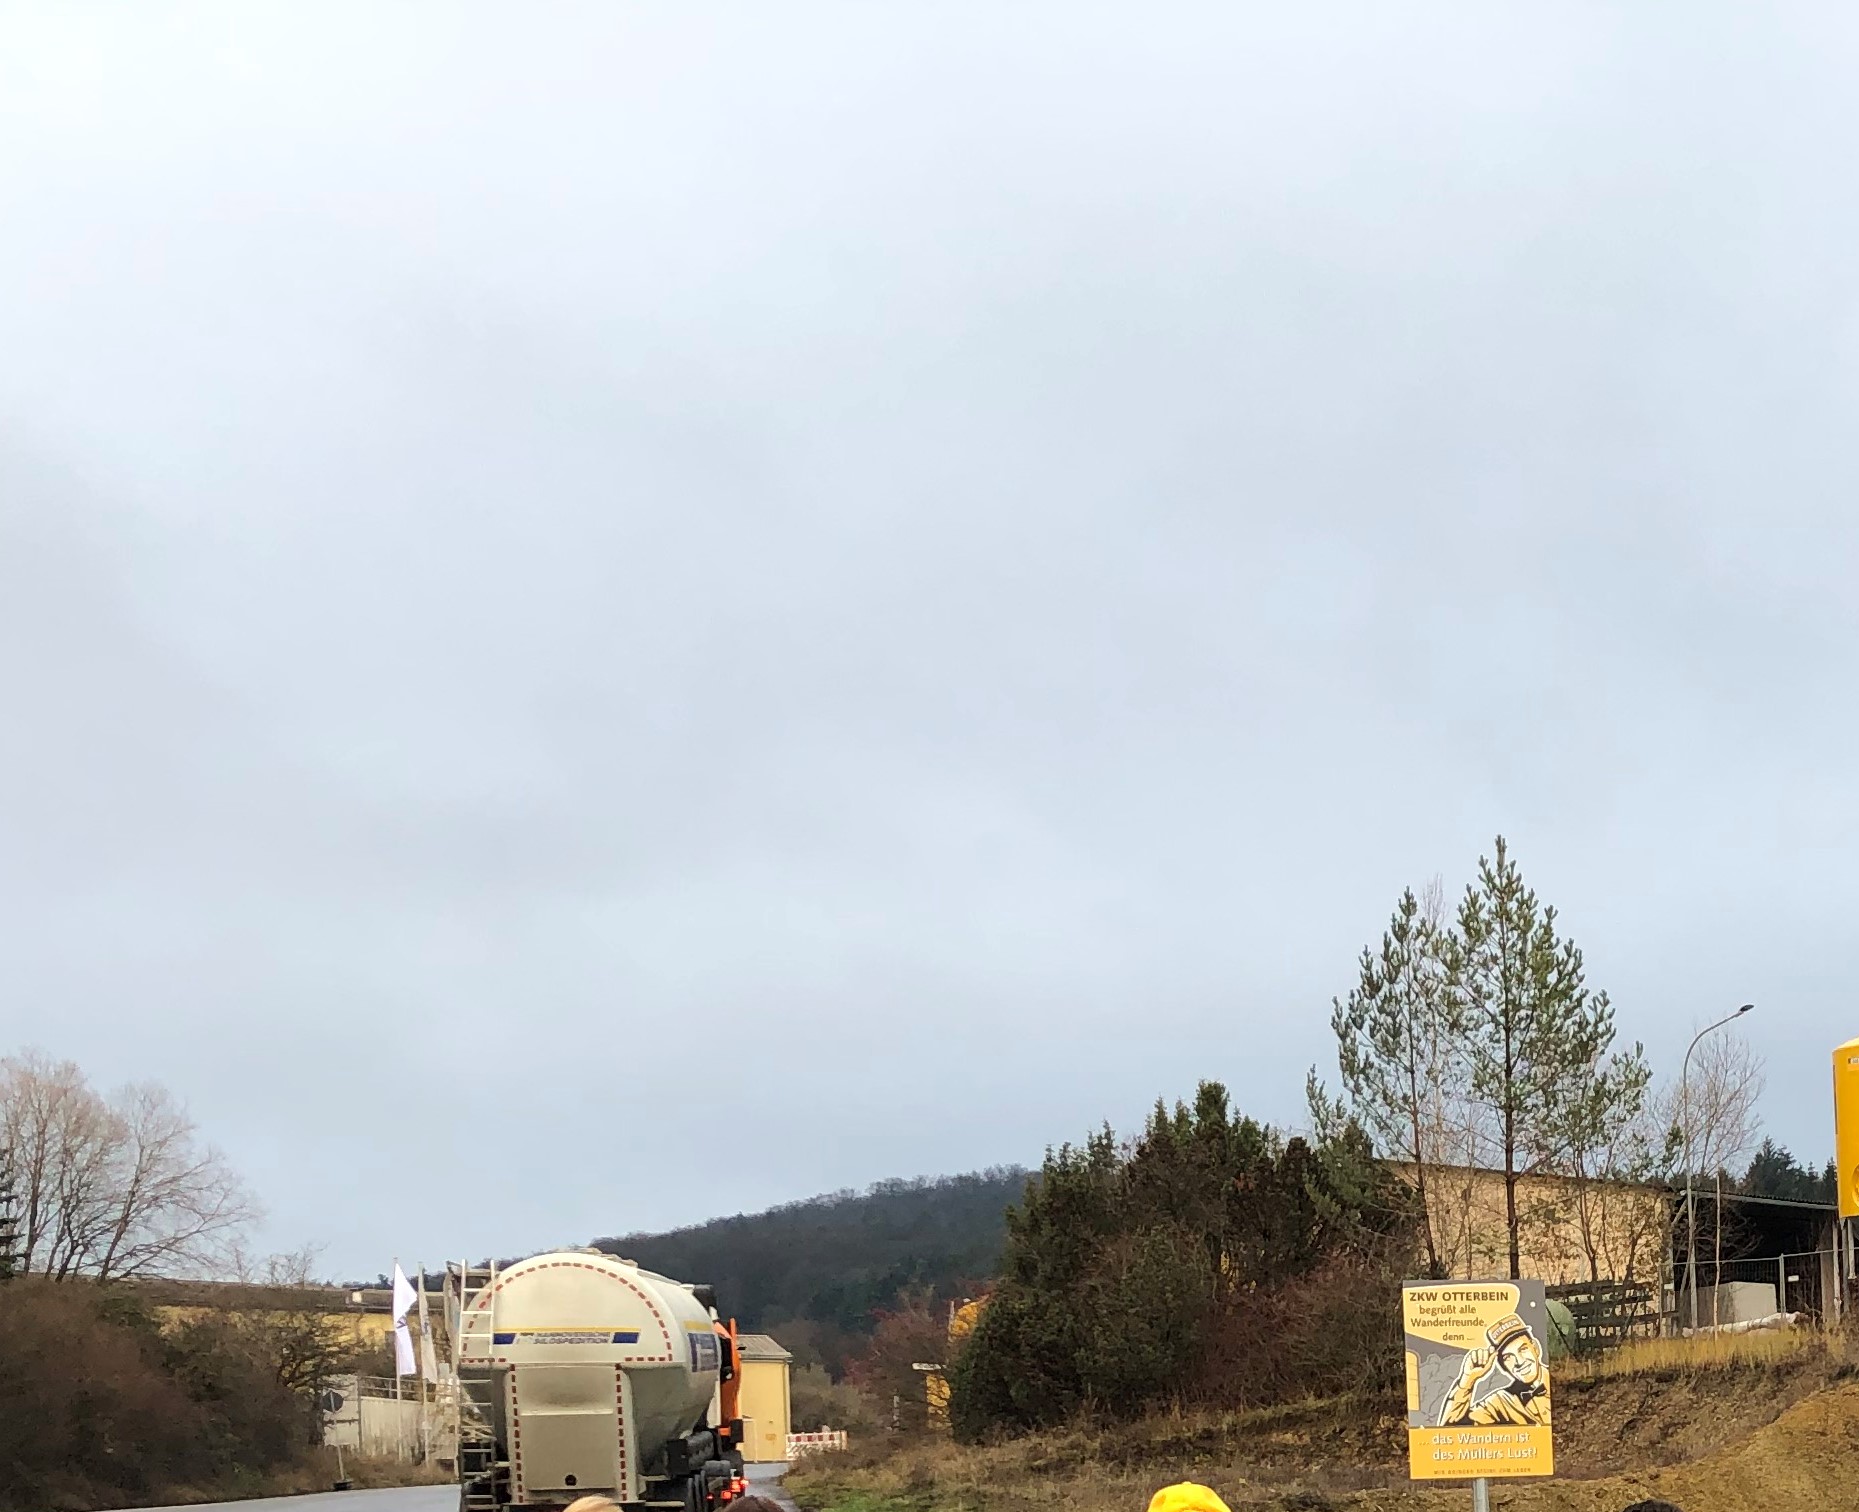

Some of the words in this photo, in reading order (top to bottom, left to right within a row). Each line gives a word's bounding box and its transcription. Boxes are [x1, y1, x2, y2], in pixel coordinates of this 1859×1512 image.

[1409, 1292, 1438, 1301] ZKW
[1442, 1291, 1509, 1301] OTTERBEIN
[1419, 1305, 1456, 1316] begrüßt
[1459, 1305, 1476, 1315] alle
[1442, 1332, 1464, 1341] denn
[1432, 1433, 1453, 1445] das
[1457, 1431, 1511, 1445] Wandern
[1515, 1431, 1531, 1443] ist
[1432, 1449, 1454, 1461] des
[1458, 1448, 1504, 1460] Müllers
[1507, 1447, 1537, 1459] Lust!
